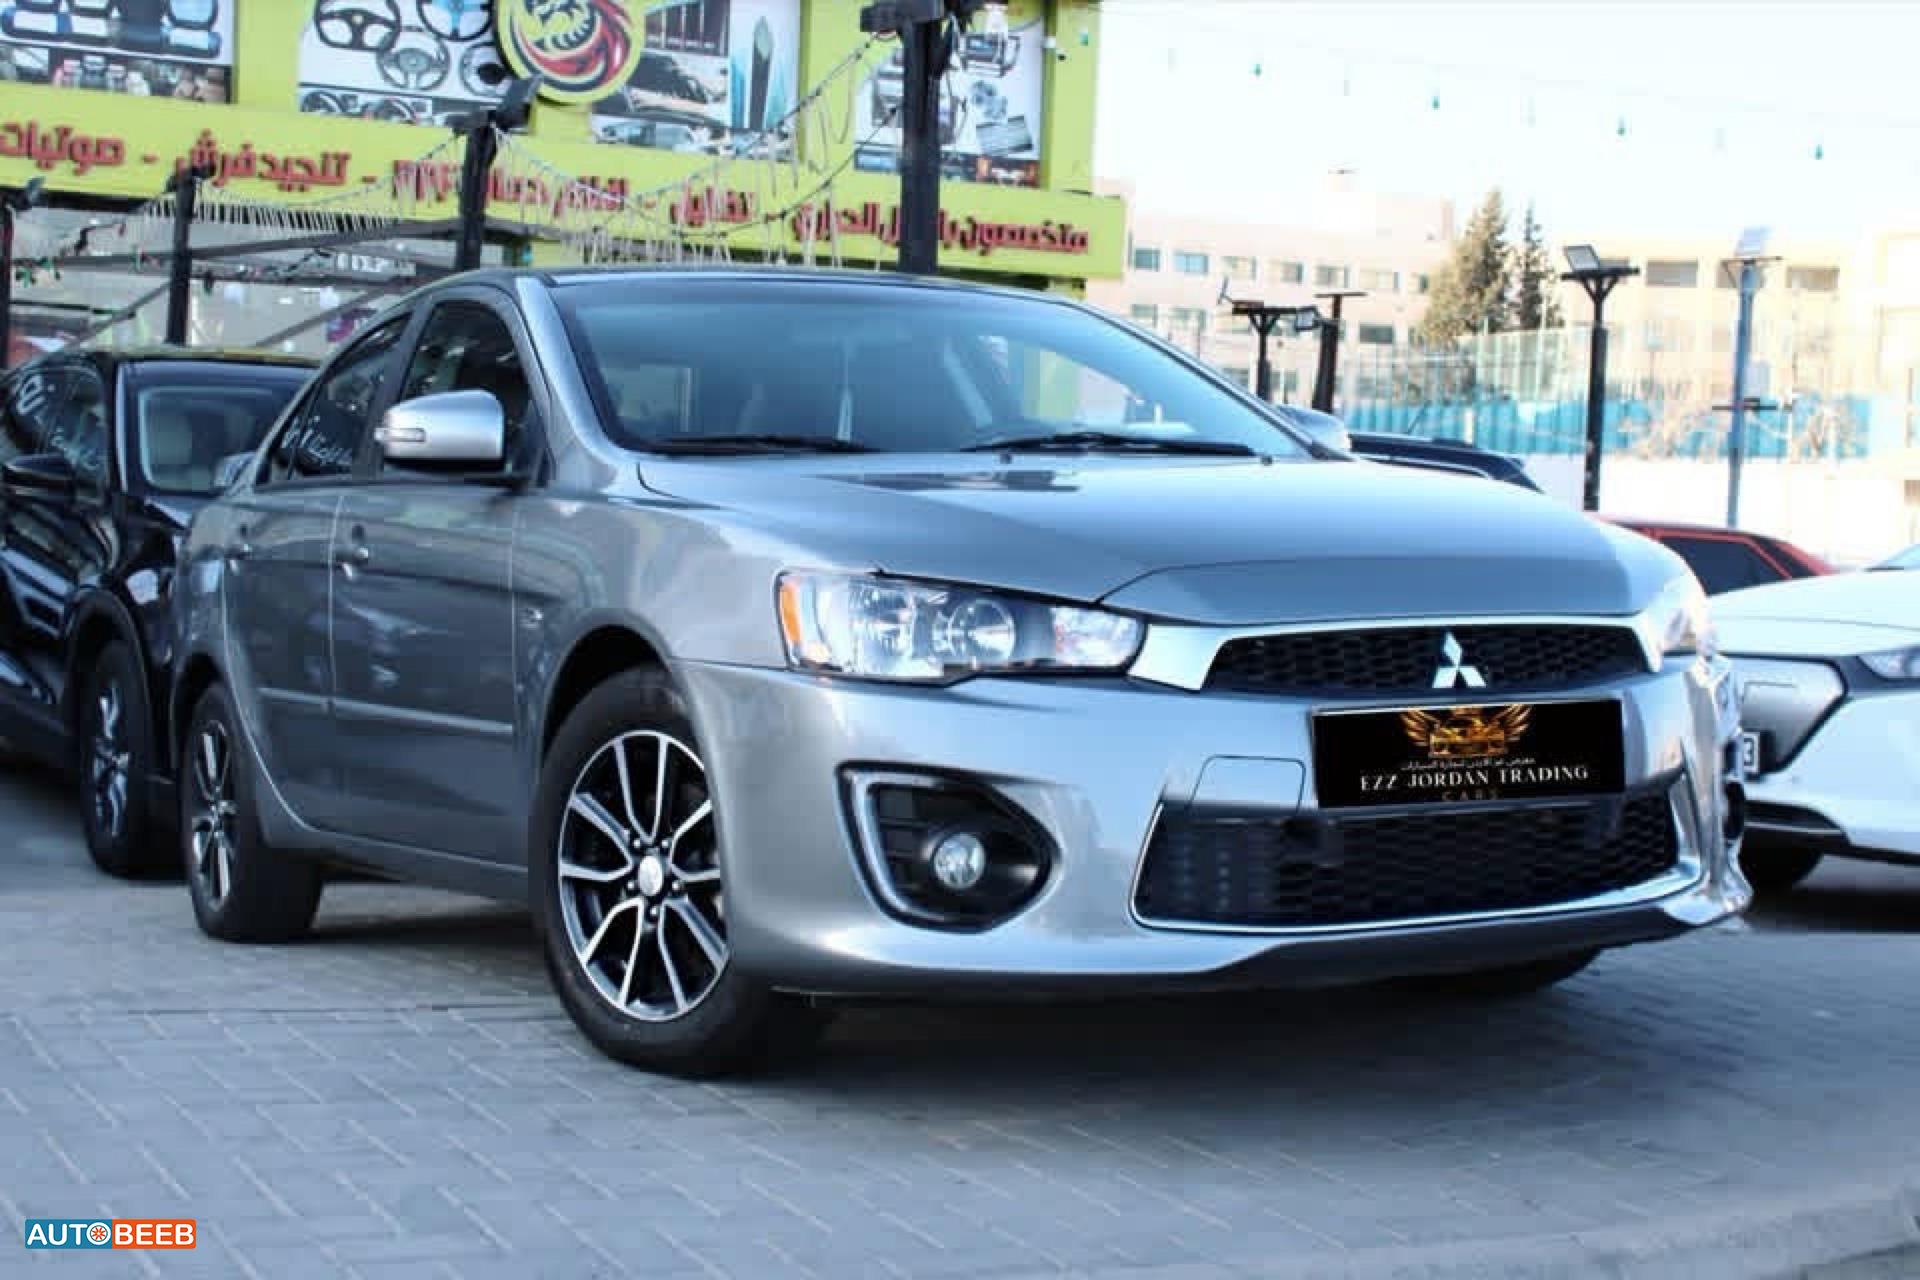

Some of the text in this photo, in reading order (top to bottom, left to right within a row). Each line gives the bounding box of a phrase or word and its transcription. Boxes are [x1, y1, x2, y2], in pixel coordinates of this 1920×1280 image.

[1360, 765, 1589, 791] EZZ JORDAN TRADING
